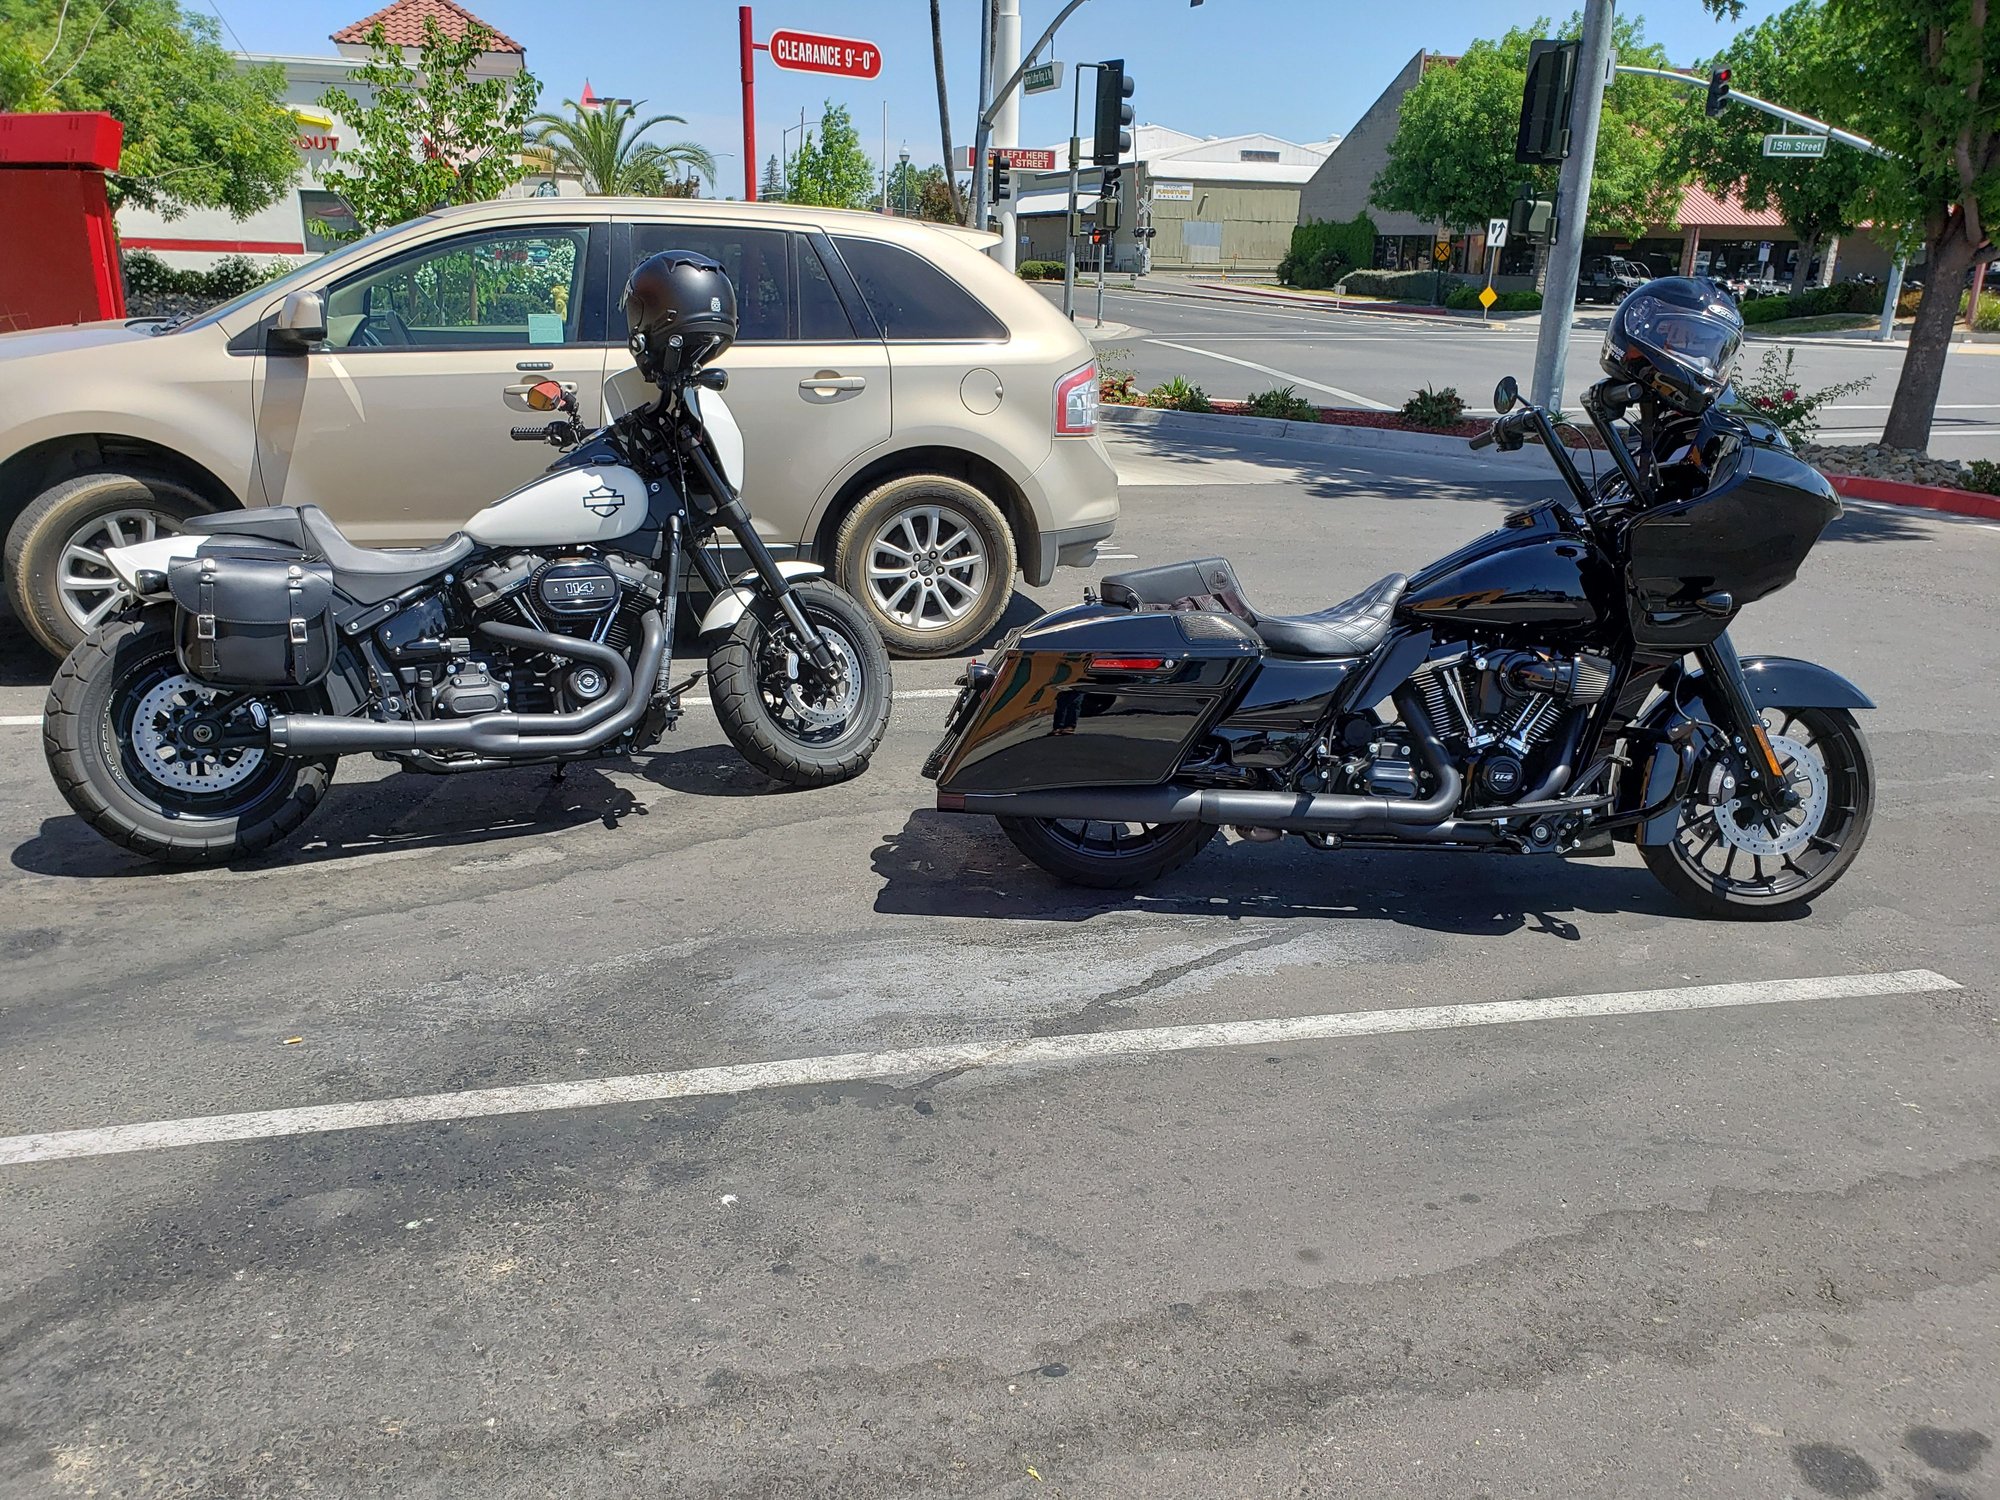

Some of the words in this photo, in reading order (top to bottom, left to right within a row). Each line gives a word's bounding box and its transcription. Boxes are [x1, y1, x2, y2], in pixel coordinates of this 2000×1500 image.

[778, 39, 841, 67] CLEARANCE
[1773, 141, 1791, 151] 15th
[1794, 141, 1822, 152] Street
[1002, 150, 1024, 159] LEFT
[1026, 151, 1049, 160] HERE
[1016, 159, 1049, 168] STREET
[565, 582, 595, 593] 114
